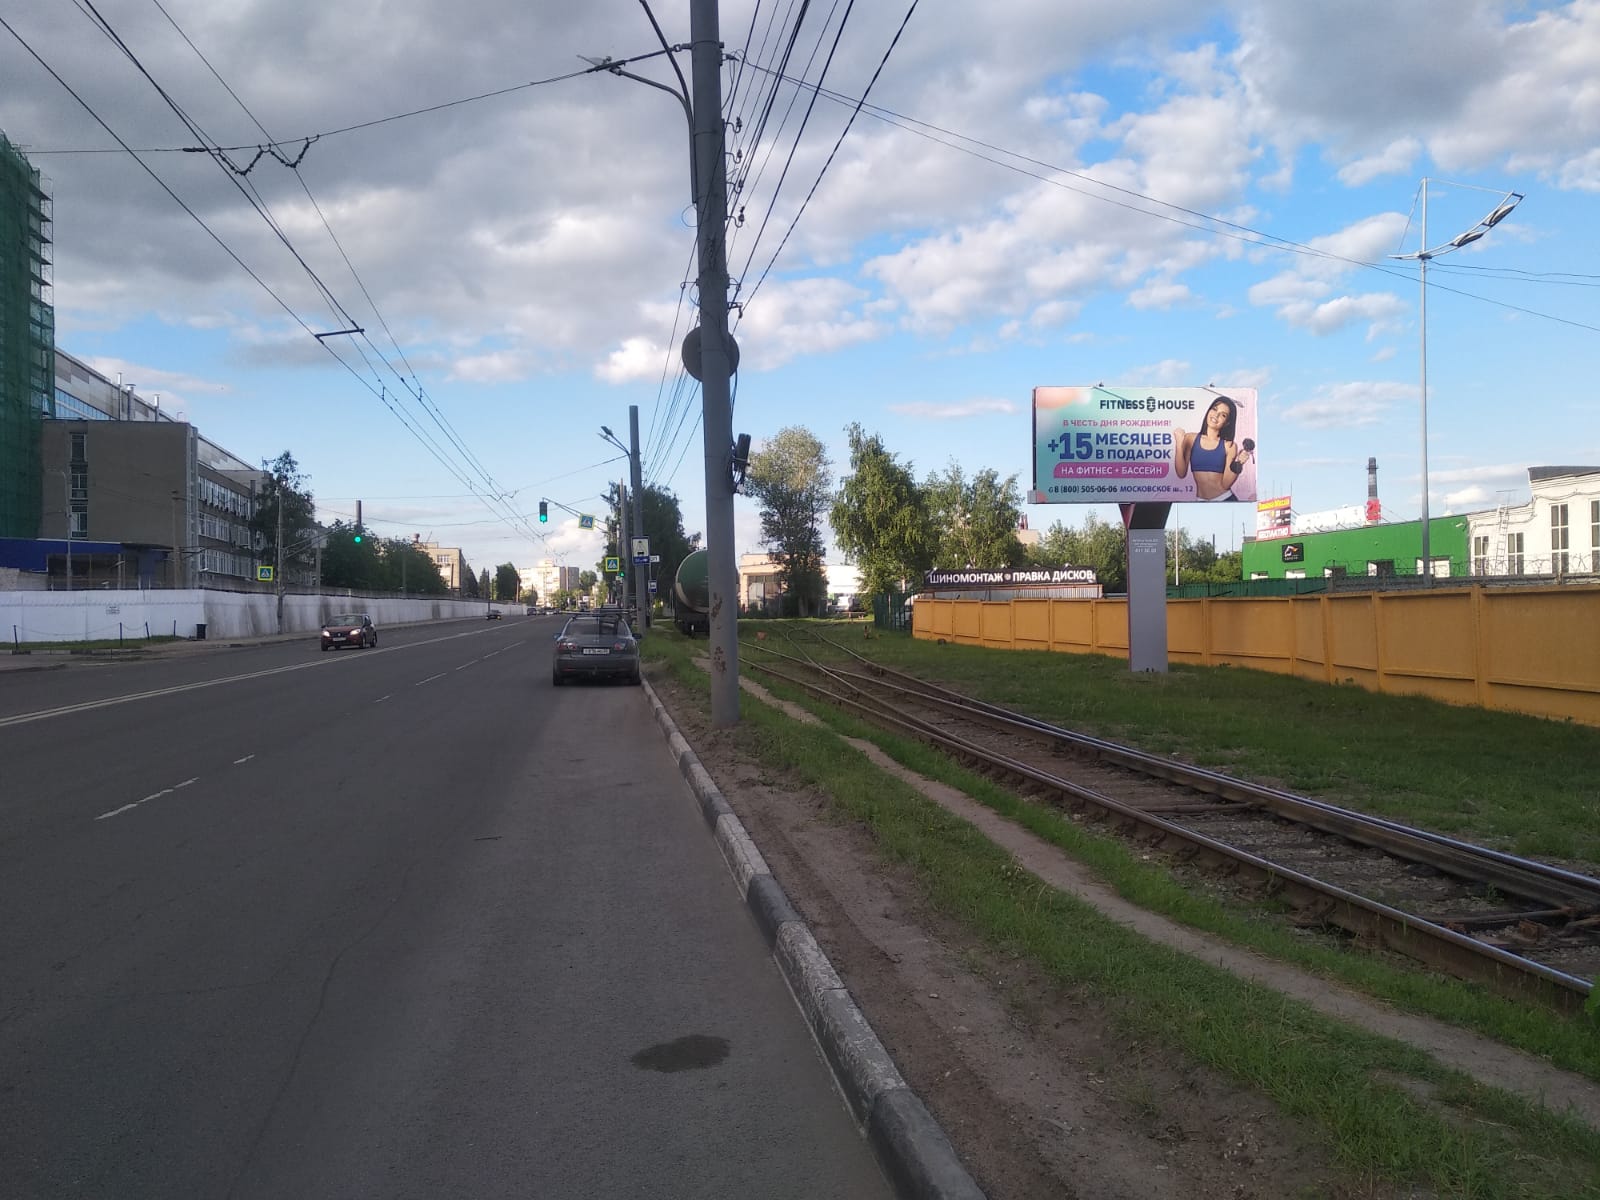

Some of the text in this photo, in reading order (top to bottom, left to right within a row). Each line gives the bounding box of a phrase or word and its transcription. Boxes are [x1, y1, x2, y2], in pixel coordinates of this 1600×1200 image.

[1100, 399, 1195, 410] FITNESS HOUSE
[1063, 419, 1172, 428] В ЧЕСТЬ ДНЯ РОЖДЕНИЯ!
[1096, 433, 1172, 447] МЕСЯЦЕВ
[1047, 432, 1093, 460] +15
[1096, 449, 1171, 461] В ПОДАРОК
[1061, 466, 1075, 474] НА
[1076, 466, 1113, 474] ФИТНЕС
[1121, 465, 1162, 475] БАССЕЙН
[1054, 485, 1059, 493] 8
[1060, 485, 1079, 493] (800)
[1081, 485, 1118, 493] 505-06-06
[1120, 485, 1171, 493] МОСКОВСКОЕ
[1185, 485, 1193, 493] 12
[929, 569, 1093, 584] ШИНОМОНТАЖ ПРАВКА ДИСКОВ
